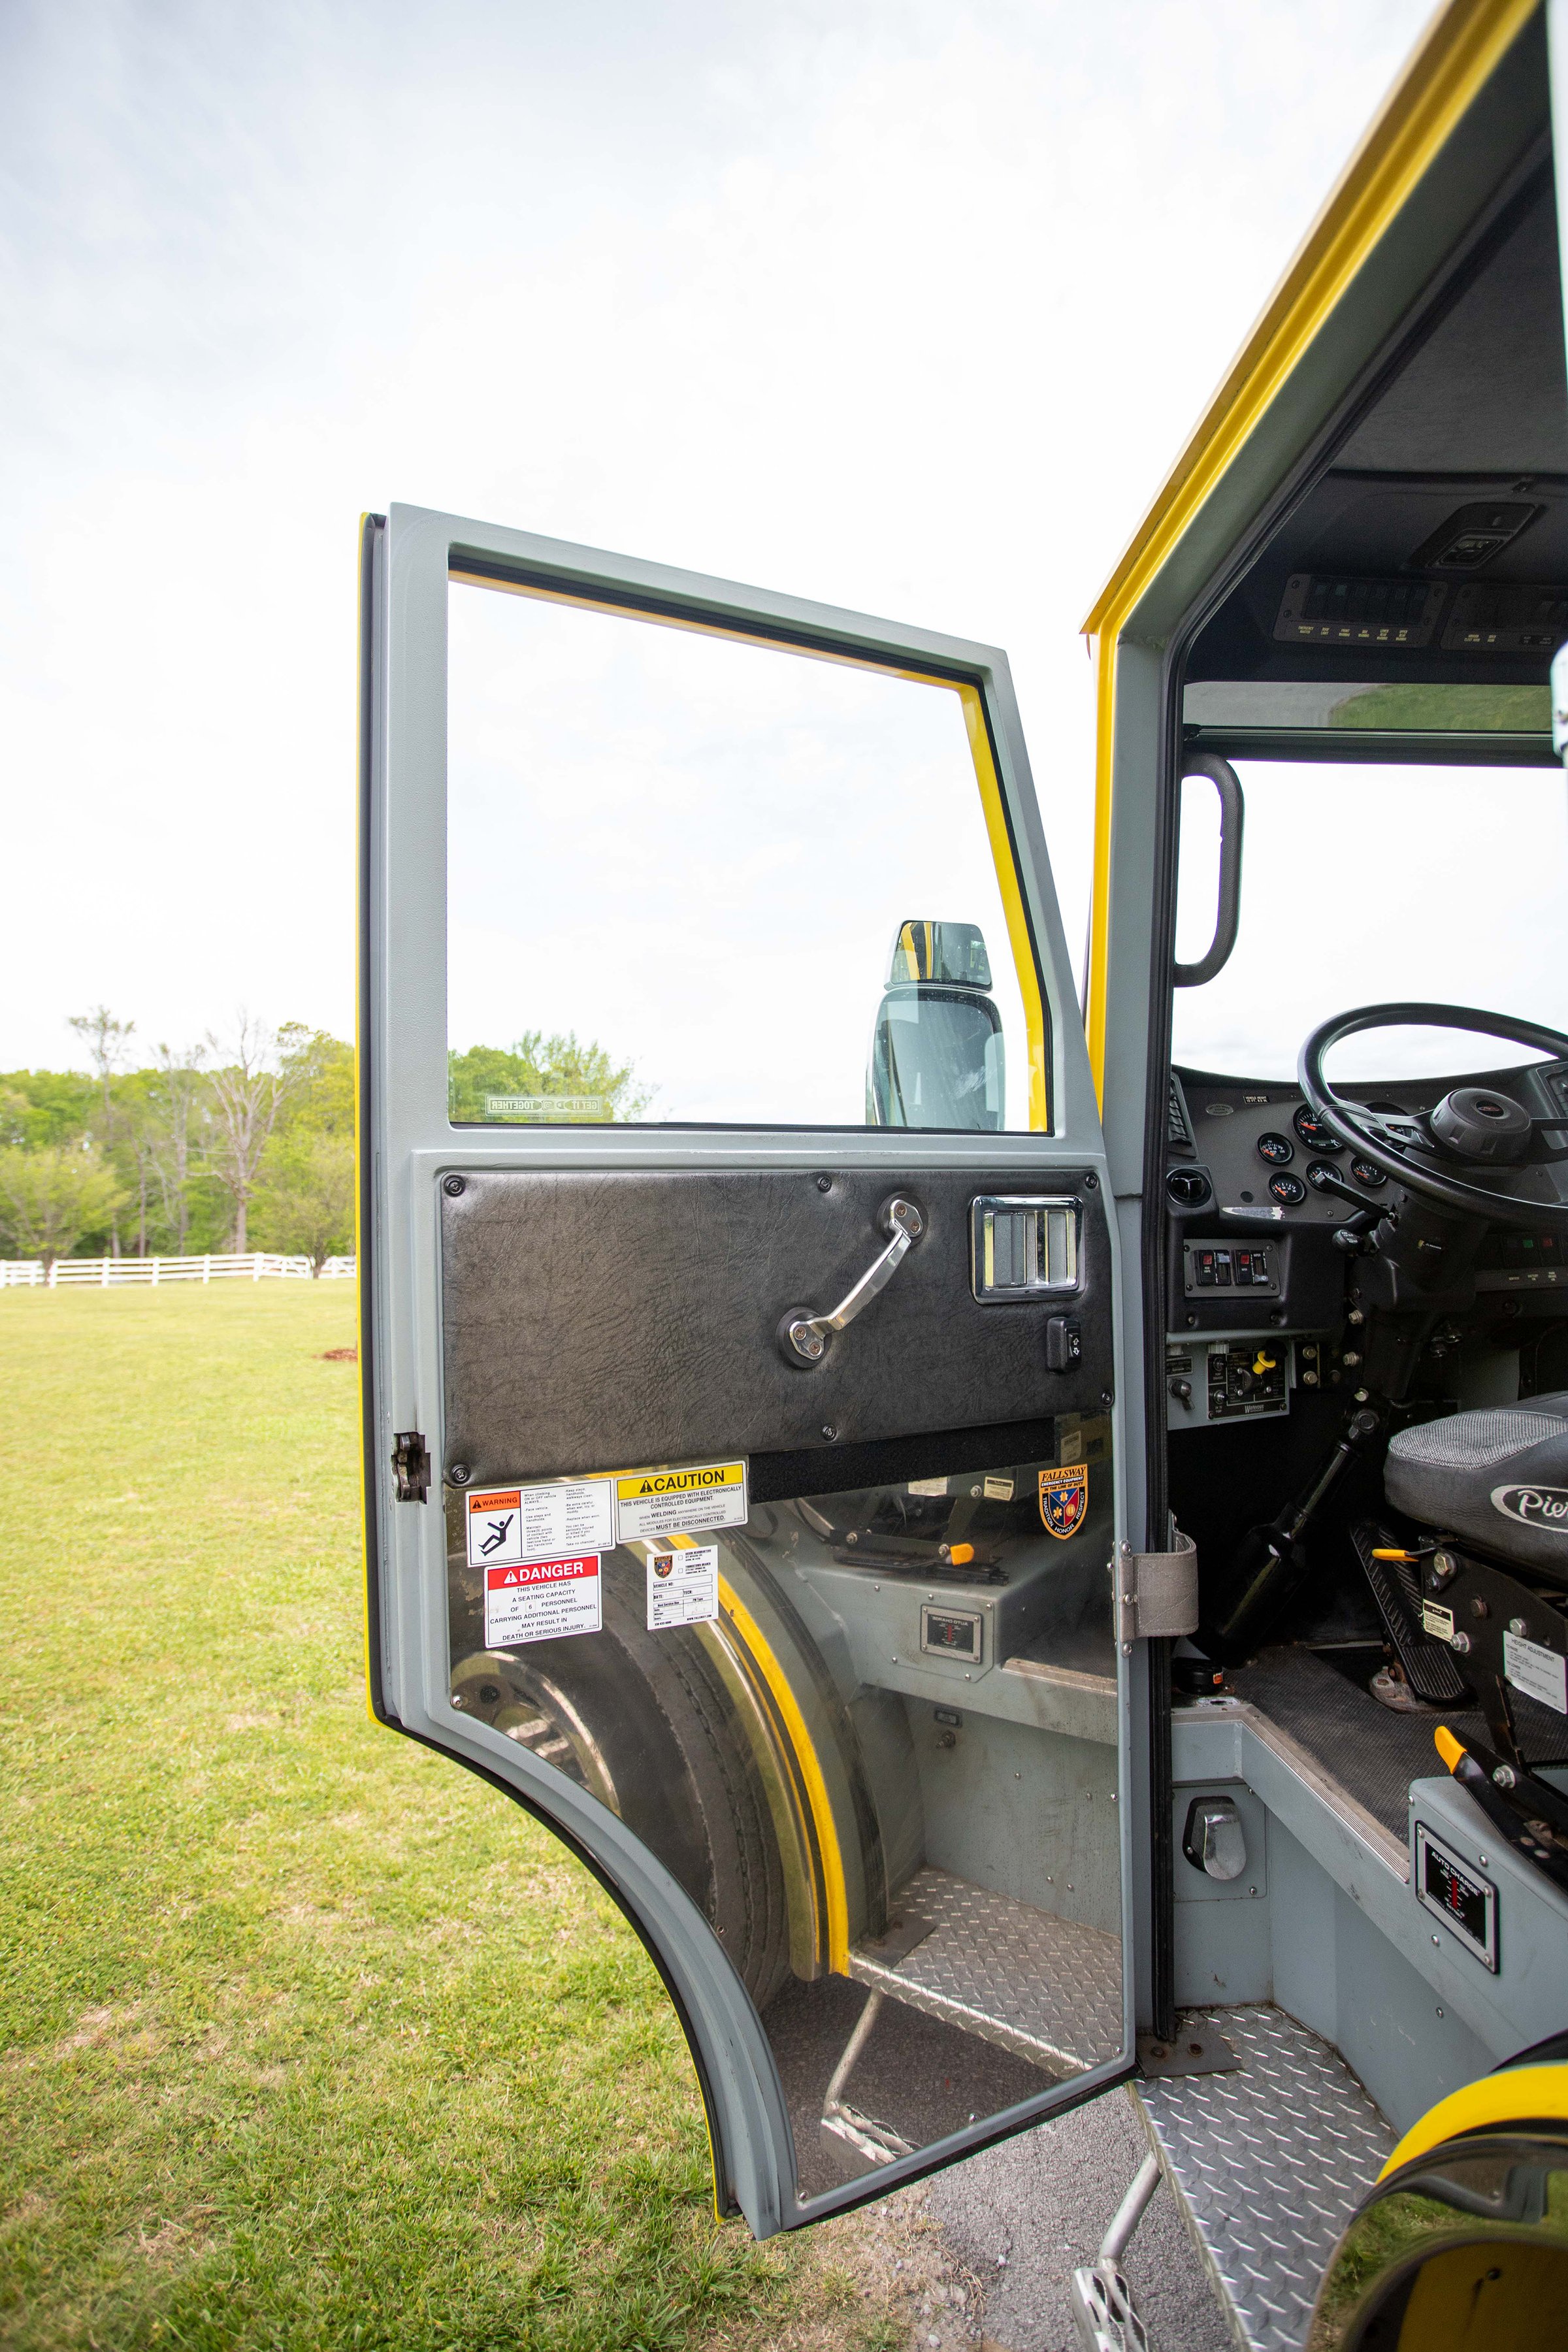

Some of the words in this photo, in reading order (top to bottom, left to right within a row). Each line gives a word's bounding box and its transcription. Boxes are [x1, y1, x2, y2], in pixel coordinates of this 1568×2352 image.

[654, 1469, 725, 1492] CAUTION
[1042, 1467, 1086, 1482] FALLSWAY
[661, 1494, 686, 1502] EQUIPPED
[700, 1486, 742, 1496] ELECTRONICALLY
[482, 1497, 517, 1506] WARNING
[651, 1499, 684, 1509] CONTROLLED
[685, 1495, 714, 1505] EQUIPMENT.
[1075, 1492, 1085, 1520] RESPECT
[672, 1513, 702, 1522] ELECTRONICALLY
[1043, 1497, 1054, 1527] TRADITION
[681, 1515, 725, 1526] DISCONNECTED.
[1054, 1524, 1075, 1533] HONOR
[519, 1561, 583, 1582] DANGER
[532, 1582, 557, 1591] VEHICLE
[518, 1593, 544, 1602] SEATING
[546, 1590, 576, 1598] CAPACITY
[541, 1597, 578, 1607] PERSONNEL
[490, 1614, 522, 1624] CARRYING
[524, 1609, 560, 1619] ADDITIONAL
[561, 1604, 596, 1614] PERSONNEL
[535, 1627, 561, 1635] SERIOUS
[1511, 1639, 1527, 1648] HEIGHT
[1527, 1646, 1555, 1662] ADJUSTMENT
[1431, 1851, 1450, 1870] AUTO
[1450, 1867, 1479, 1897] CHARGE
